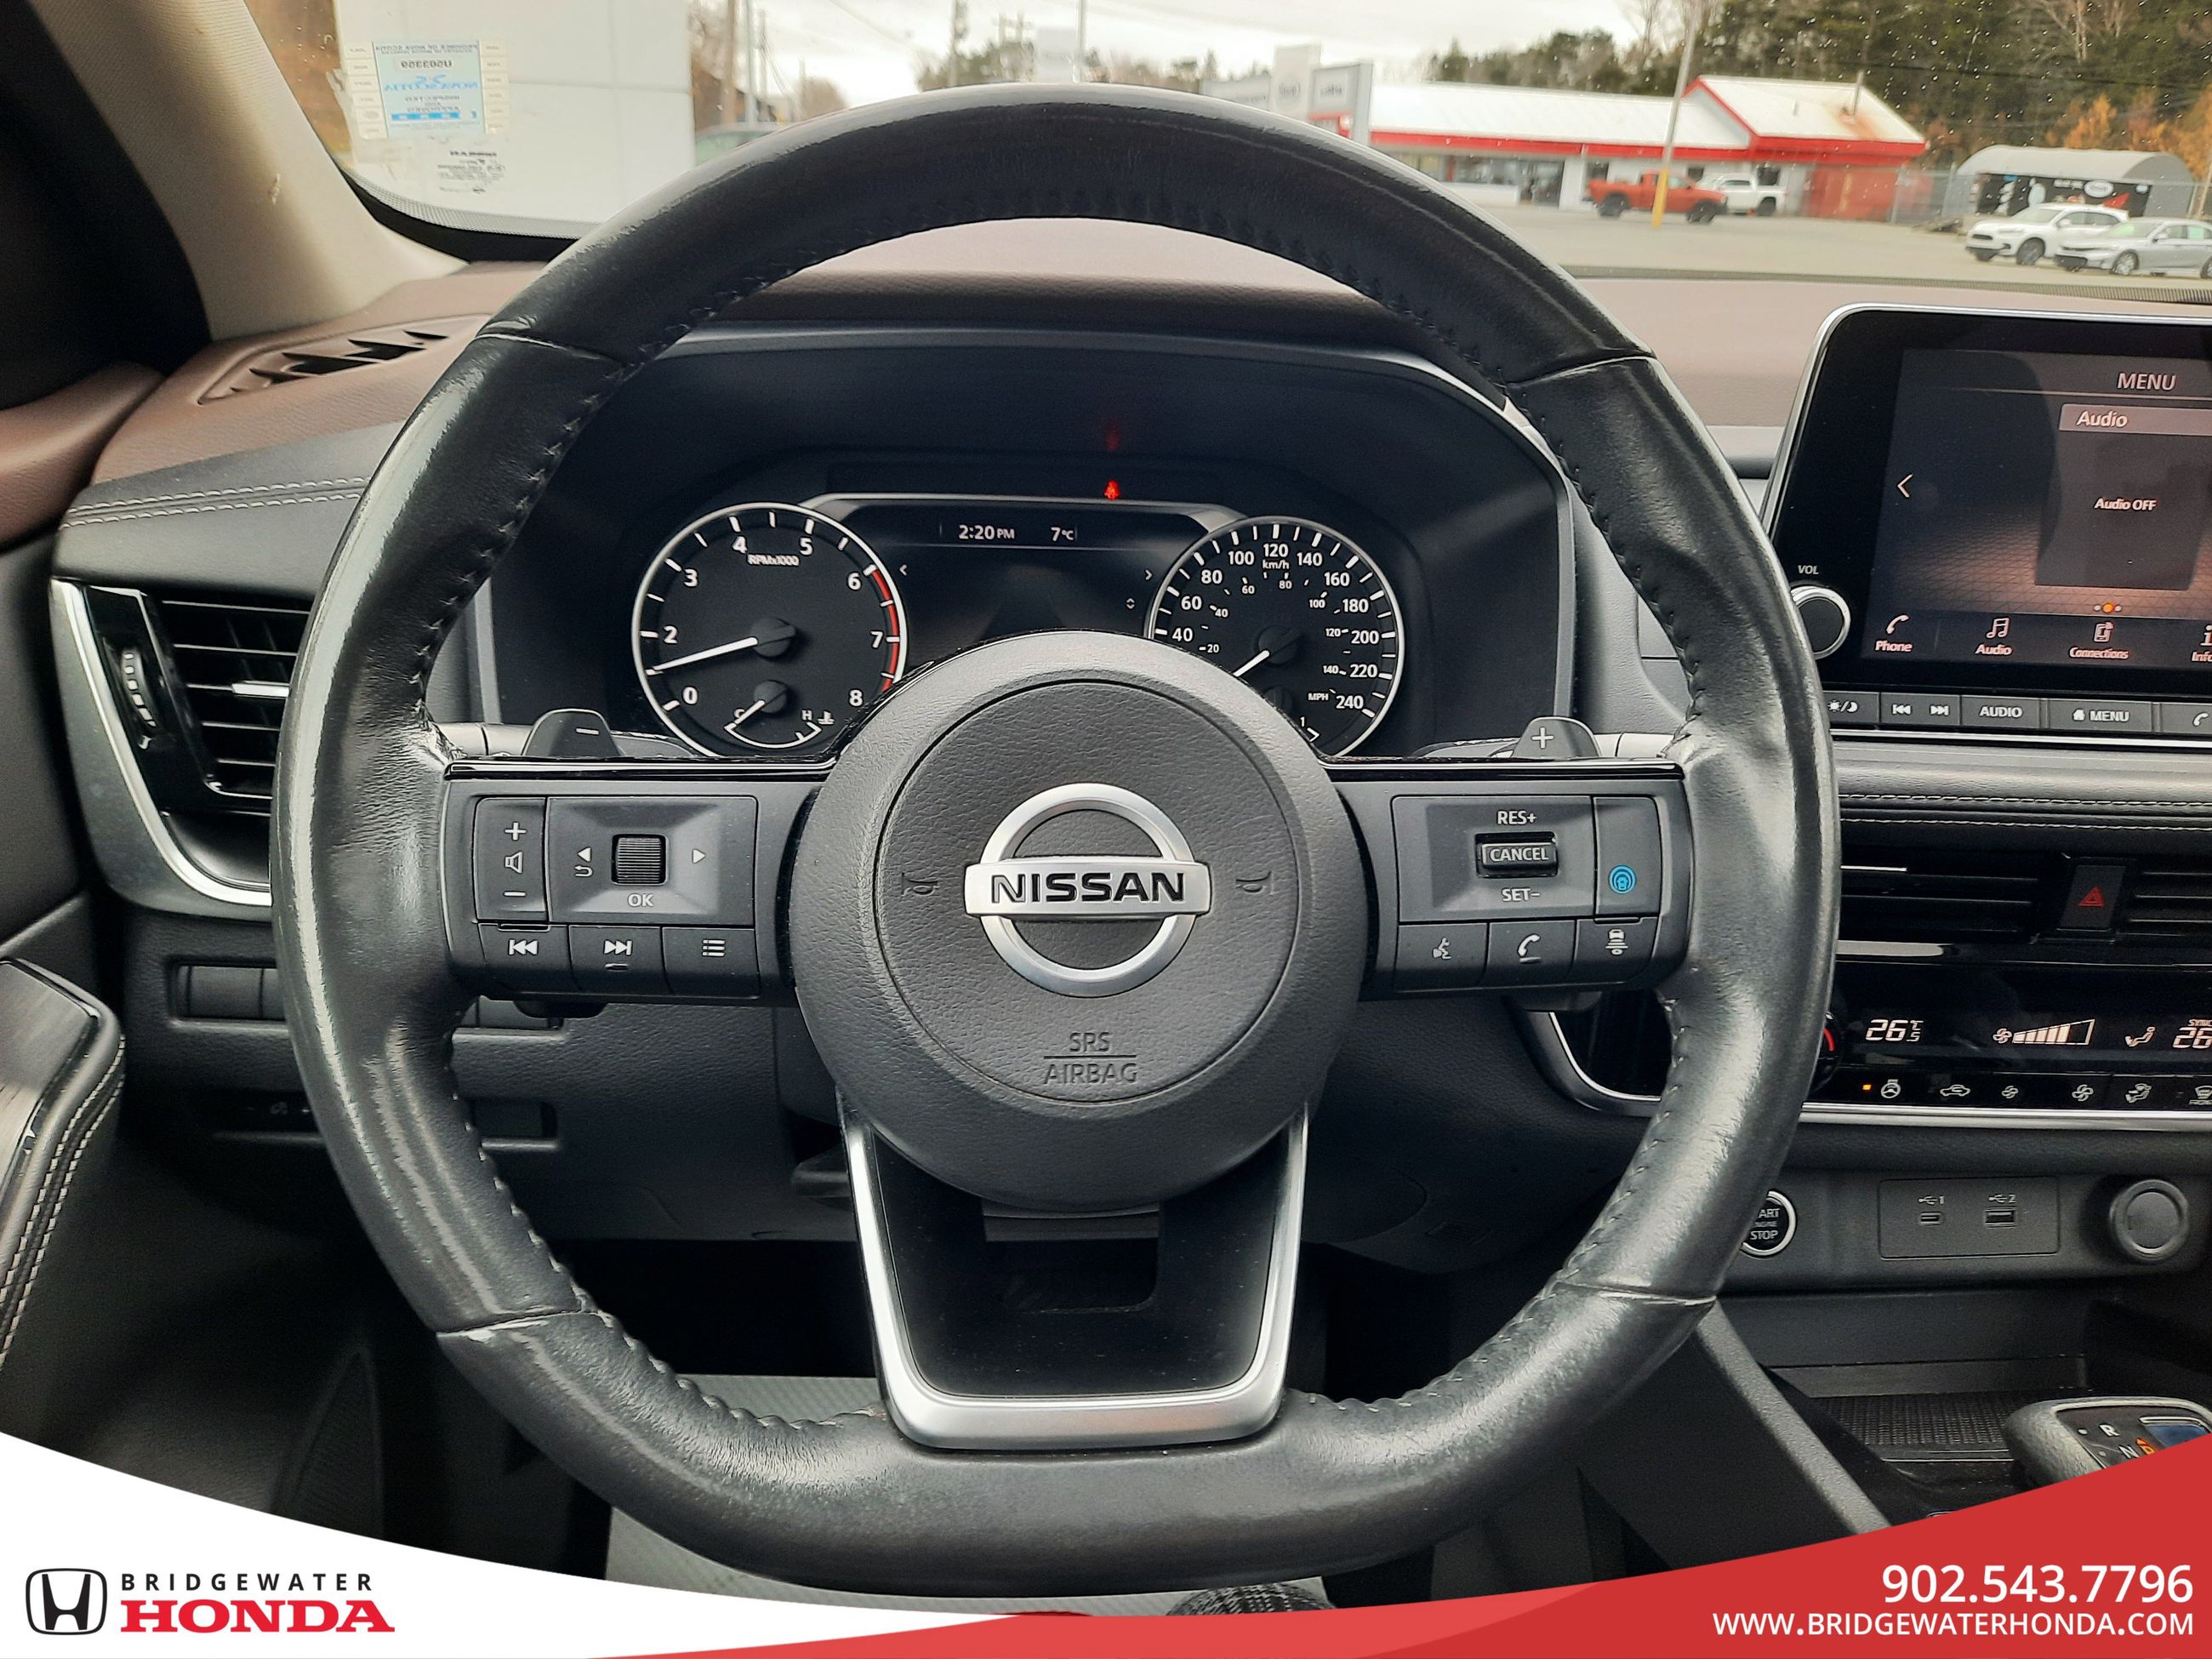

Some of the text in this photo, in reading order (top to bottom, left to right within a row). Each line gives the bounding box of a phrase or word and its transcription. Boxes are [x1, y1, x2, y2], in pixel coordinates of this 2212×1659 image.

[2117, 373, 2177, 391] MENU
[2076, 410, 2128, 427] Audio
[2094, 498, 2158, 510] Audio OFF
[732, 536, 747, 554] 4
[800, 538, 813, 555] 5
[1263, 544, 1289, 557] 120
[1228, 550, 1255, 565] 100
[1263, 559, 1290, 569] km/h
[1297, 552, 1323, 566] 140
[1201, 569, 1223, 584] 80
[1798, 564, 1819, 575] VOL
[684, 568, 698, 587] 3
[847, 573, 861, 590] 6
[1279, 580, 1292, 589] 80
[1324, 572, 1350, 586] 160
[1242, 585, 1255, 594] 60
[1182, 596, 1202, 610] 60
[1308, 599, 1325, 608] 100
[1343, 599, 1369, 613] 180
[1215, 607, 1229, 618] 40
[663, 625, 678, 644] 2
[870, 630, 884, 648] 7
[1172, 628, 1193, 641] 40
[1325, 628, 1341, 636] 120
[1351, 630, 1379, 644] 200
[1207, 644, 1219, 653] 20
[1875, 641, 1913, 653] Phone
[1975, 643, 2013, 656] Audio
[2069, 647, 2129, 660] Connections
[1323, 665, 1339, 674] 140
[1349, 664, 1377, 678] 220
[682, 687, 698, 704] 0
[849, 689, 863, 706] 8
[1308, 693, 1329, 701] MPH
[1336, 695, 1364, 709] 240
[801, 710, 812, 721] H
[1979, 706, 2022, 718] AUDIO
[2089, 710, 2130, 722] MENU
[1497, 810, 1536, 825] RES+
[1490, 848, 1549, 862] CANCEL
[990, 872, 1186, 904] NISSAN
[628, 893, 654, 907] OK
[1069, 1032, 1111, 1053] SRS
[1043, 1063, 1138, 1085] AIRBAG
[1758, 1208, 1781, 1218] ART
[1749, 1229, 1779, 1240] STOP
[2099, 1423, 2121, 1437] R
[2118, 1445, 2141, 1459] N
